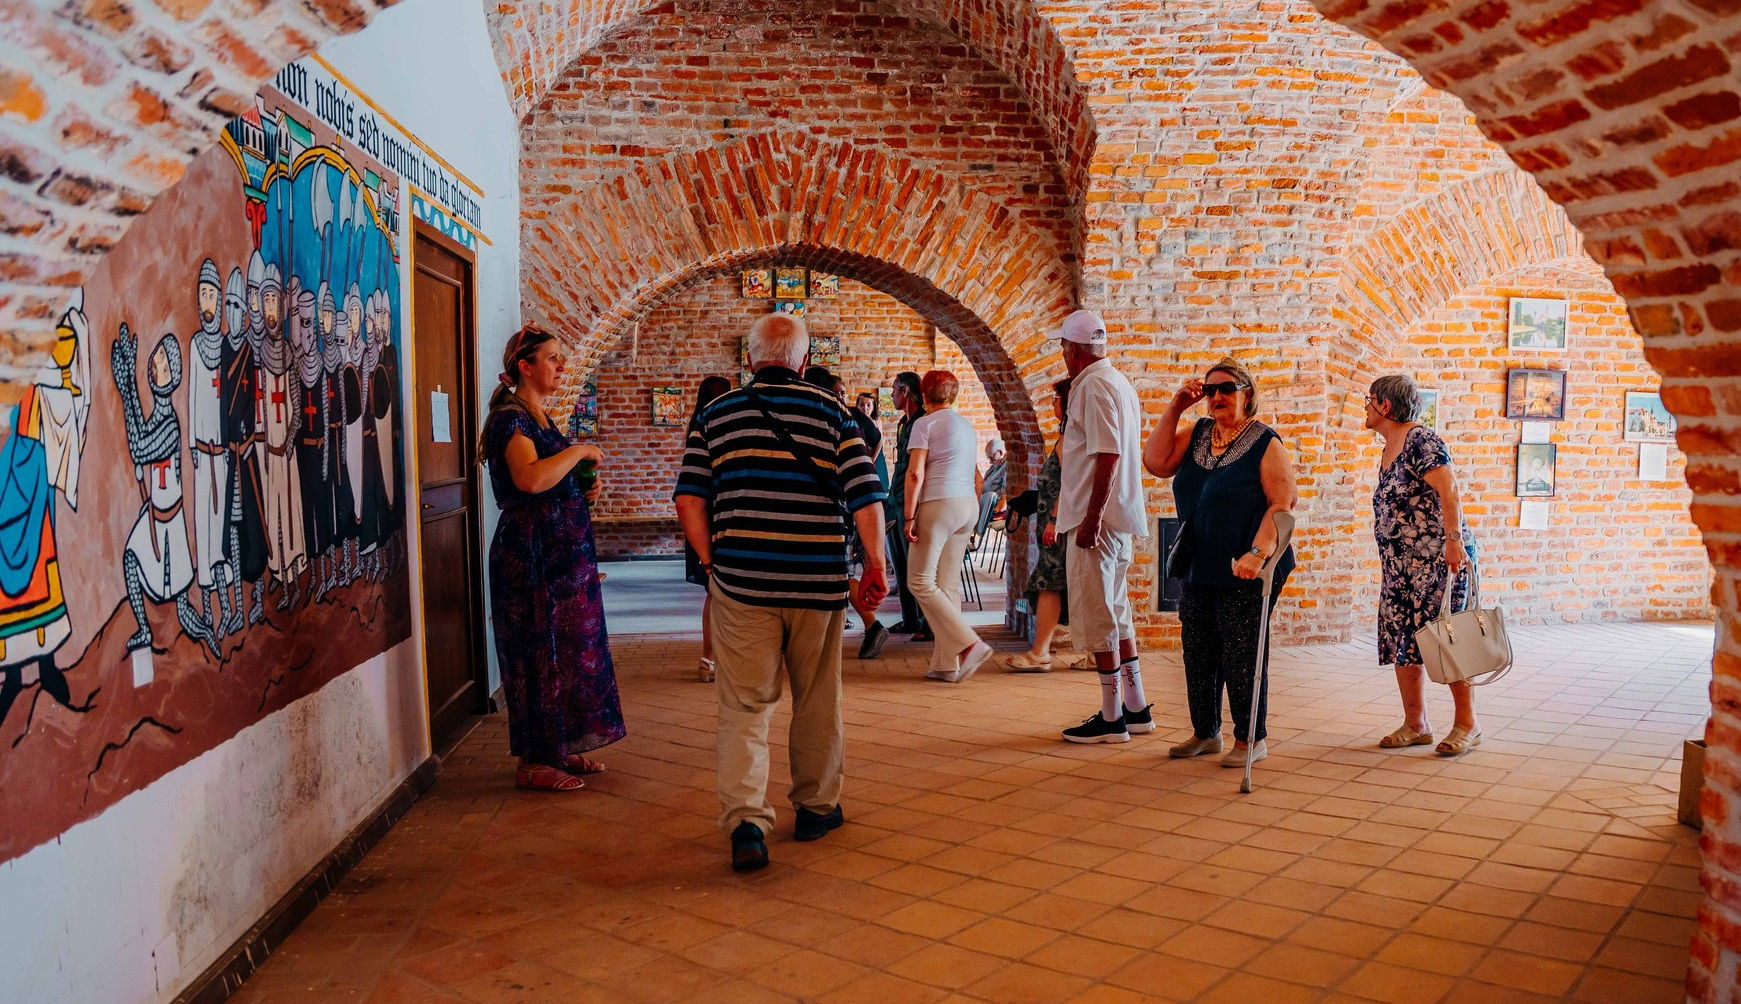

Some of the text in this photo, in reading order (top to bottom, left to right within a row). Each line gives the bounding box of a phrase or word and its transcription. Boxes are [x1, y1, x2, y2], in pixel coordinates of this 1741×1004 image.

[315, 78, 355, 140] nobis
[358, 113, 379, 159] sed
[382, 131, 420, 187] nomini
[422, 156, 437, 198] tuo
[439, 166, 449, 207] da
[451, 179, 481, 230] gloriam
